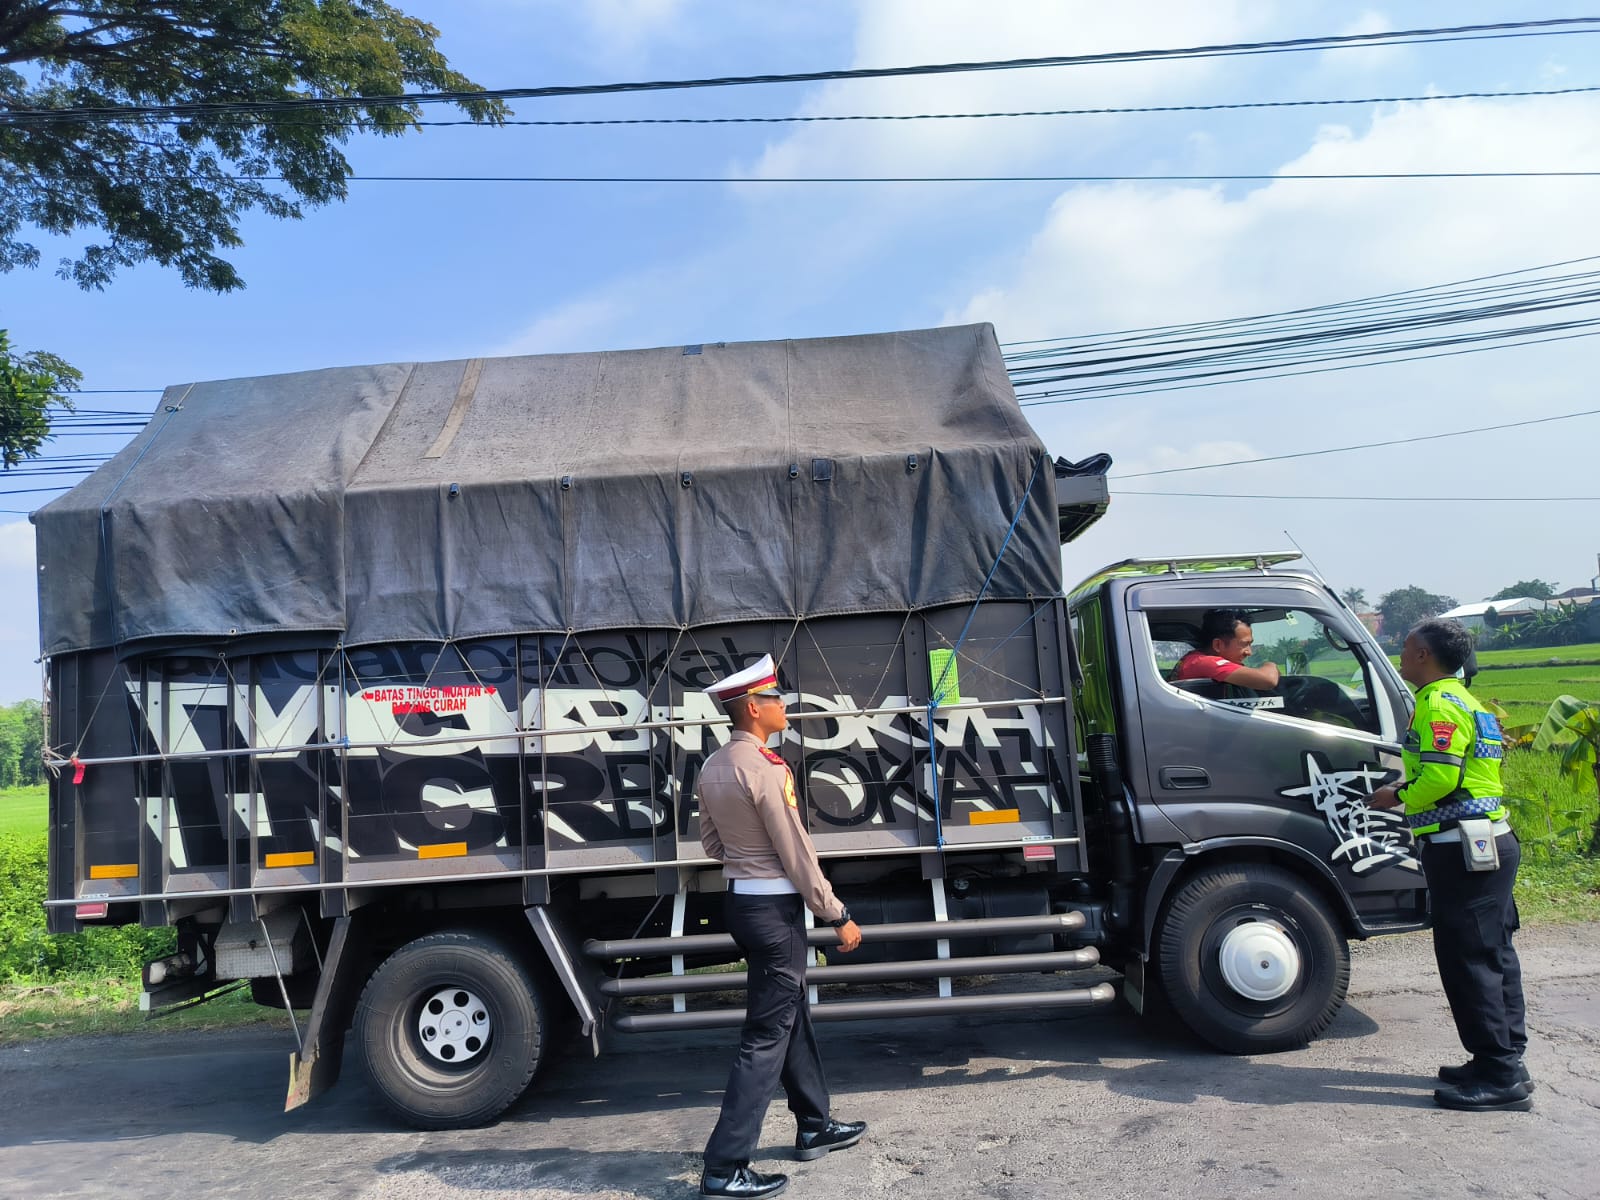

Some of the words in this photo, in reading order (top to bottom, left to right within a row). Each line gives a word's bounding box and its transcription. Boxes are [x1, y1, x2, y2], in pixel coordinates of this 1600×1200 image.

[374, 689, 404, 702] BATAS
[407, 687, 440, 700] TINGGI
[441, 685, 481, 698] MUATAN
[433, 698, 467, 712] CURAH
